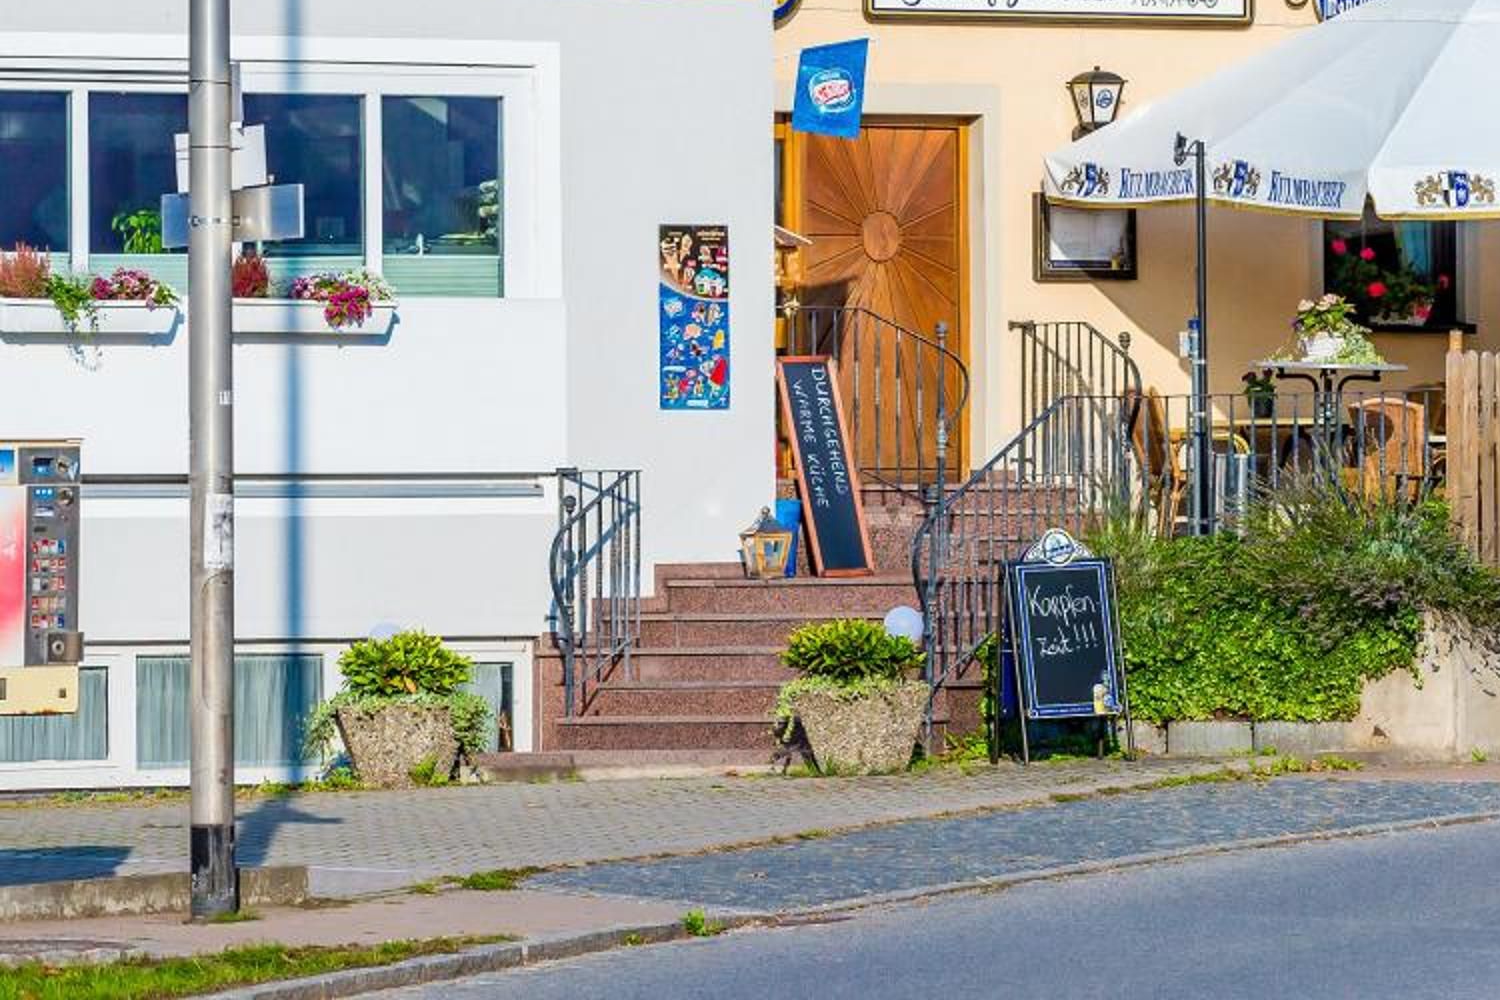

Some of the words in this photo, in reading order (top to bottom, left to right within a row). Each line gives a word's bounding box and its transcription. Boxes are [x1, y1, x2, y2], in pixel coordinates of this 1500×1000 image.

[793, 379, 817, 443] WARME
[807, 454, 829, 508] KÜCHE
[811, 366, 848, 495] DURCHGEHEND
